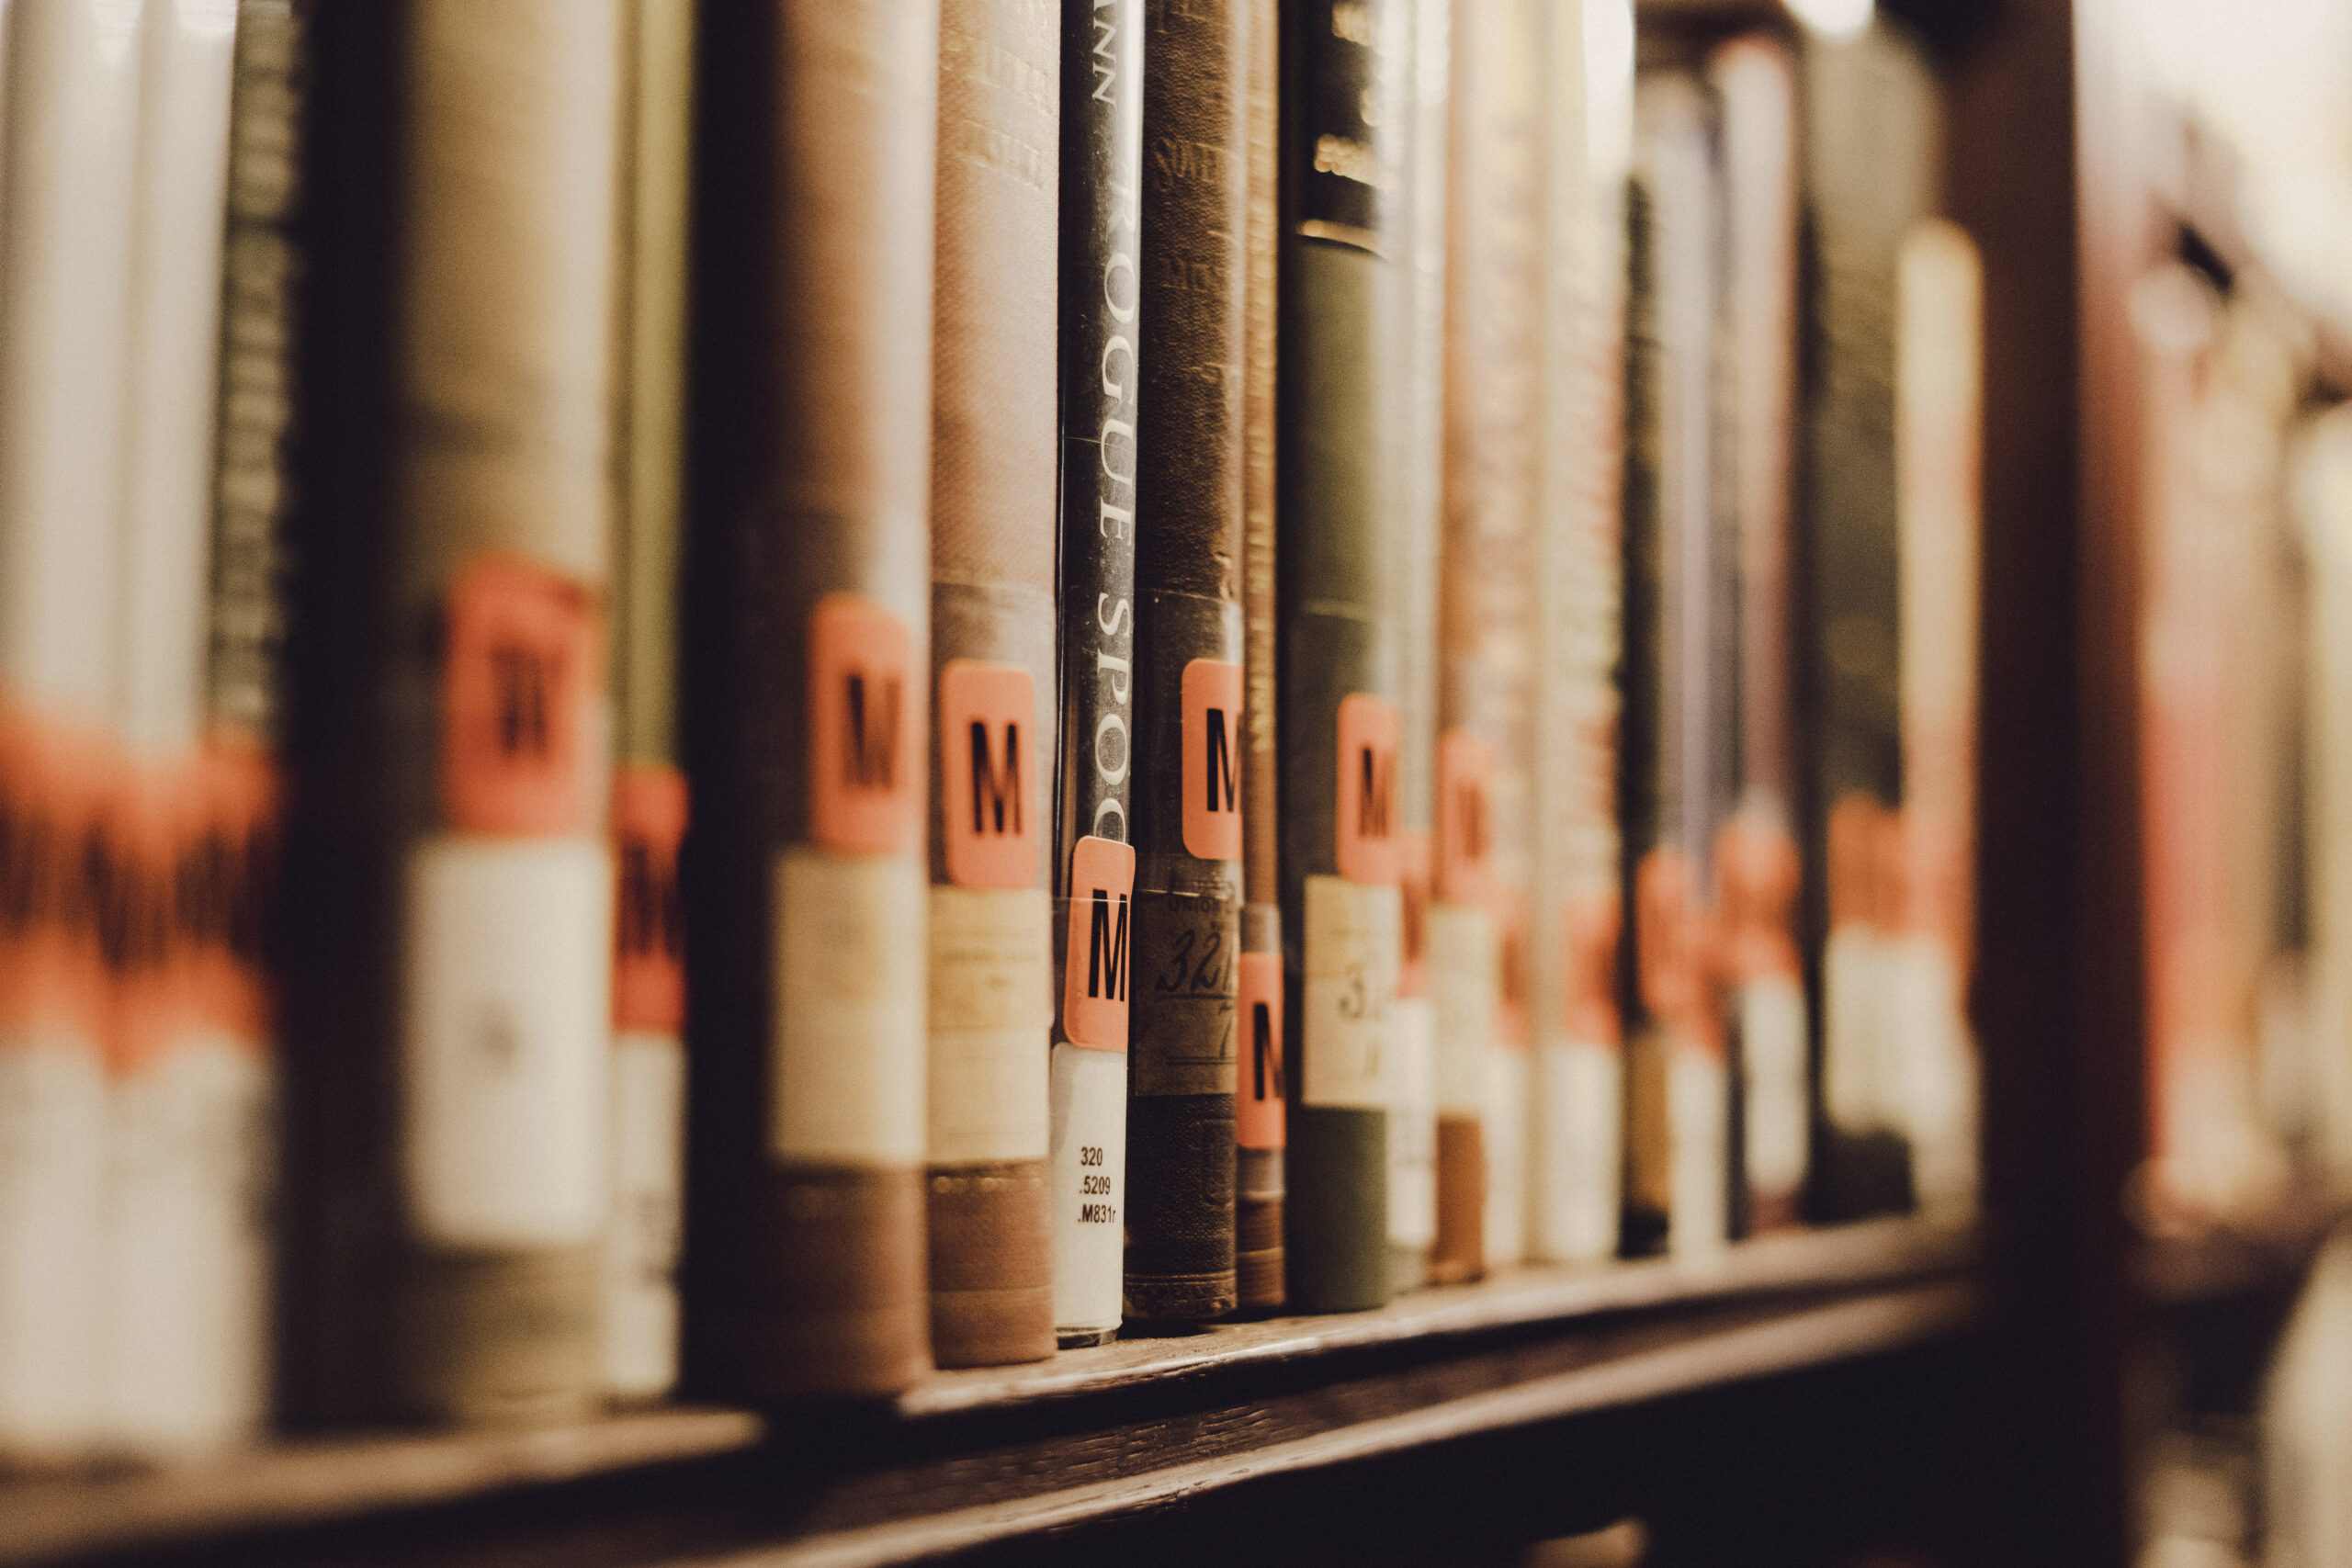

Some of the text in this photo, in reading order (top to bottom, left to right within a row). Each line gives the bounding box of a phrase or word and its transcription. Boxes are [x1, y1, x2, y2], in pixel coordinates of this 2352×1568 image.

[1092, 0, 1117, 107] NN
[970, 720, 1023, 834] M
[1088, 888, 1127, 1001] M
[1079, 1176, 1111, 1195] .5209
[1080, 1146, 1103, 1167] 320
[1077, 1203, 1116, 1224] .M831r
